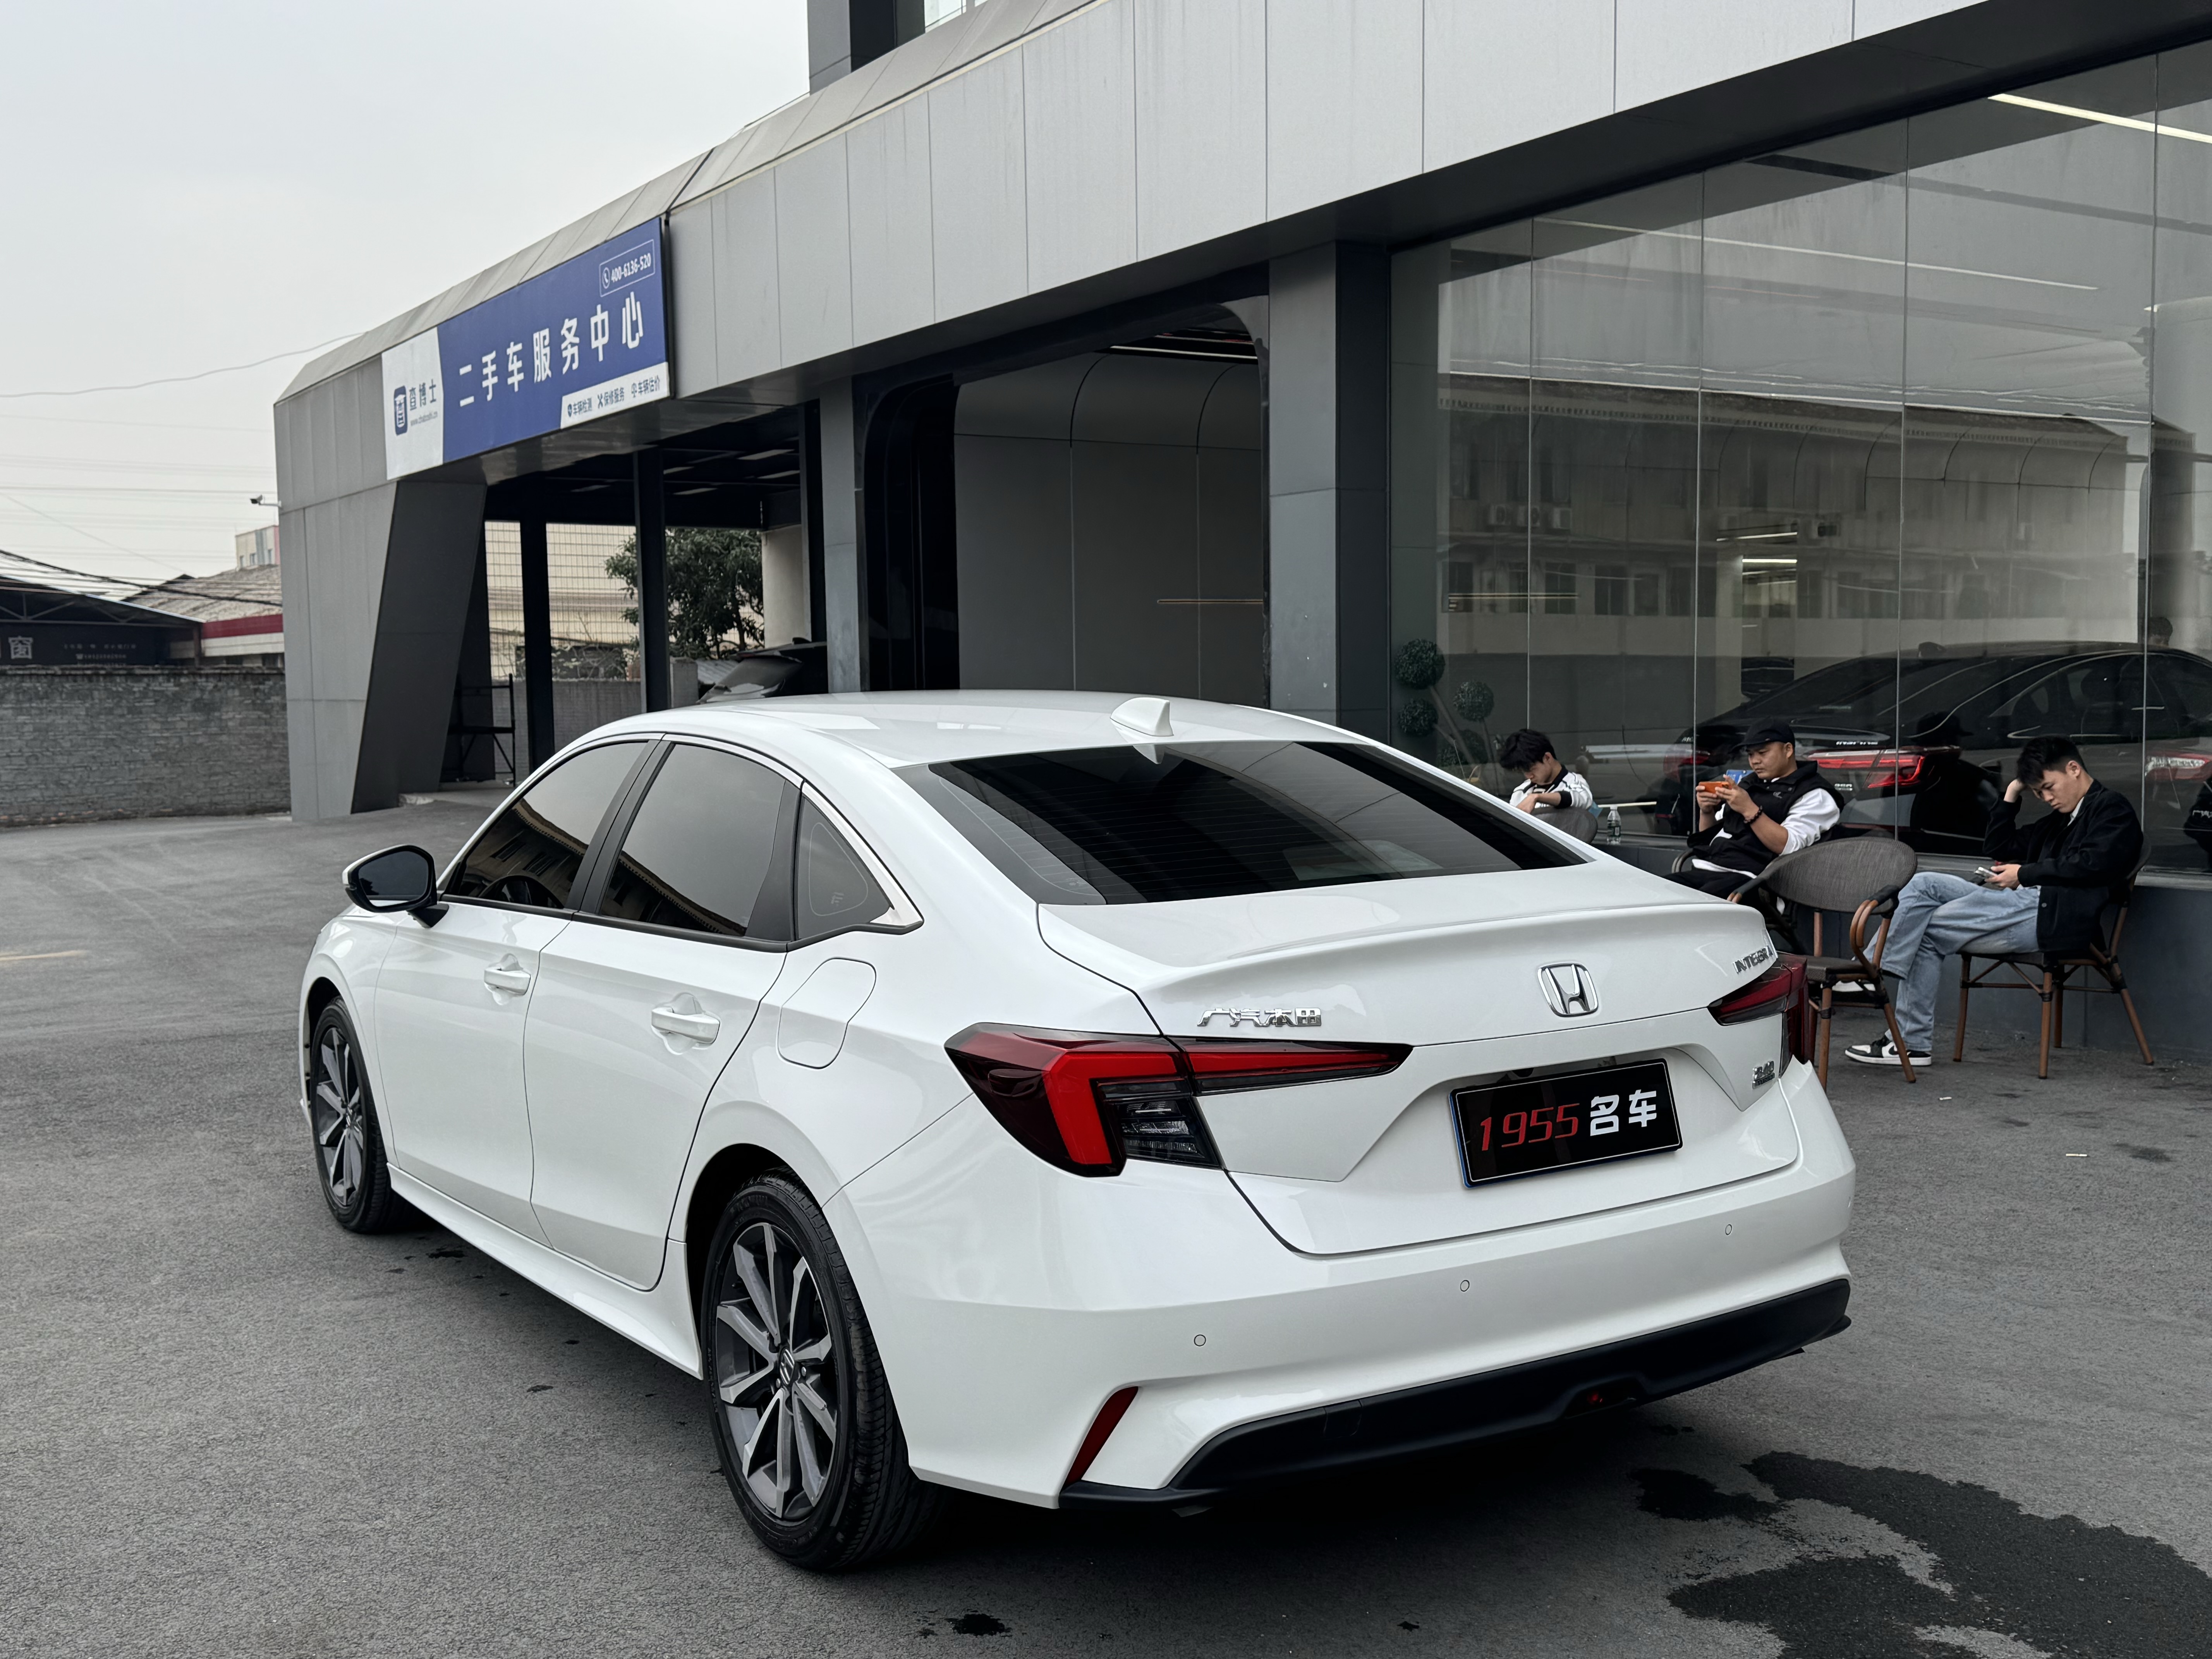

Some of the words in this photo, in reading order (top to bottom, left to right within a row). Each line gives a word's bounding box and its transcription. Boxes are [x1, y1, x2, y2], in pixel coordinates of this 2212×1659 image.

[611, 252, 651, 283] 400-6136-520
[459, 291, 643, 407] 二手车服务中心
[409, 378, 436, 411] 查博士
[0, 635, 34, 660] 窗
[1732, 945, 1774, 974] INTEGRA
[1197, 1008, 1322, 1027] 广汽本田
